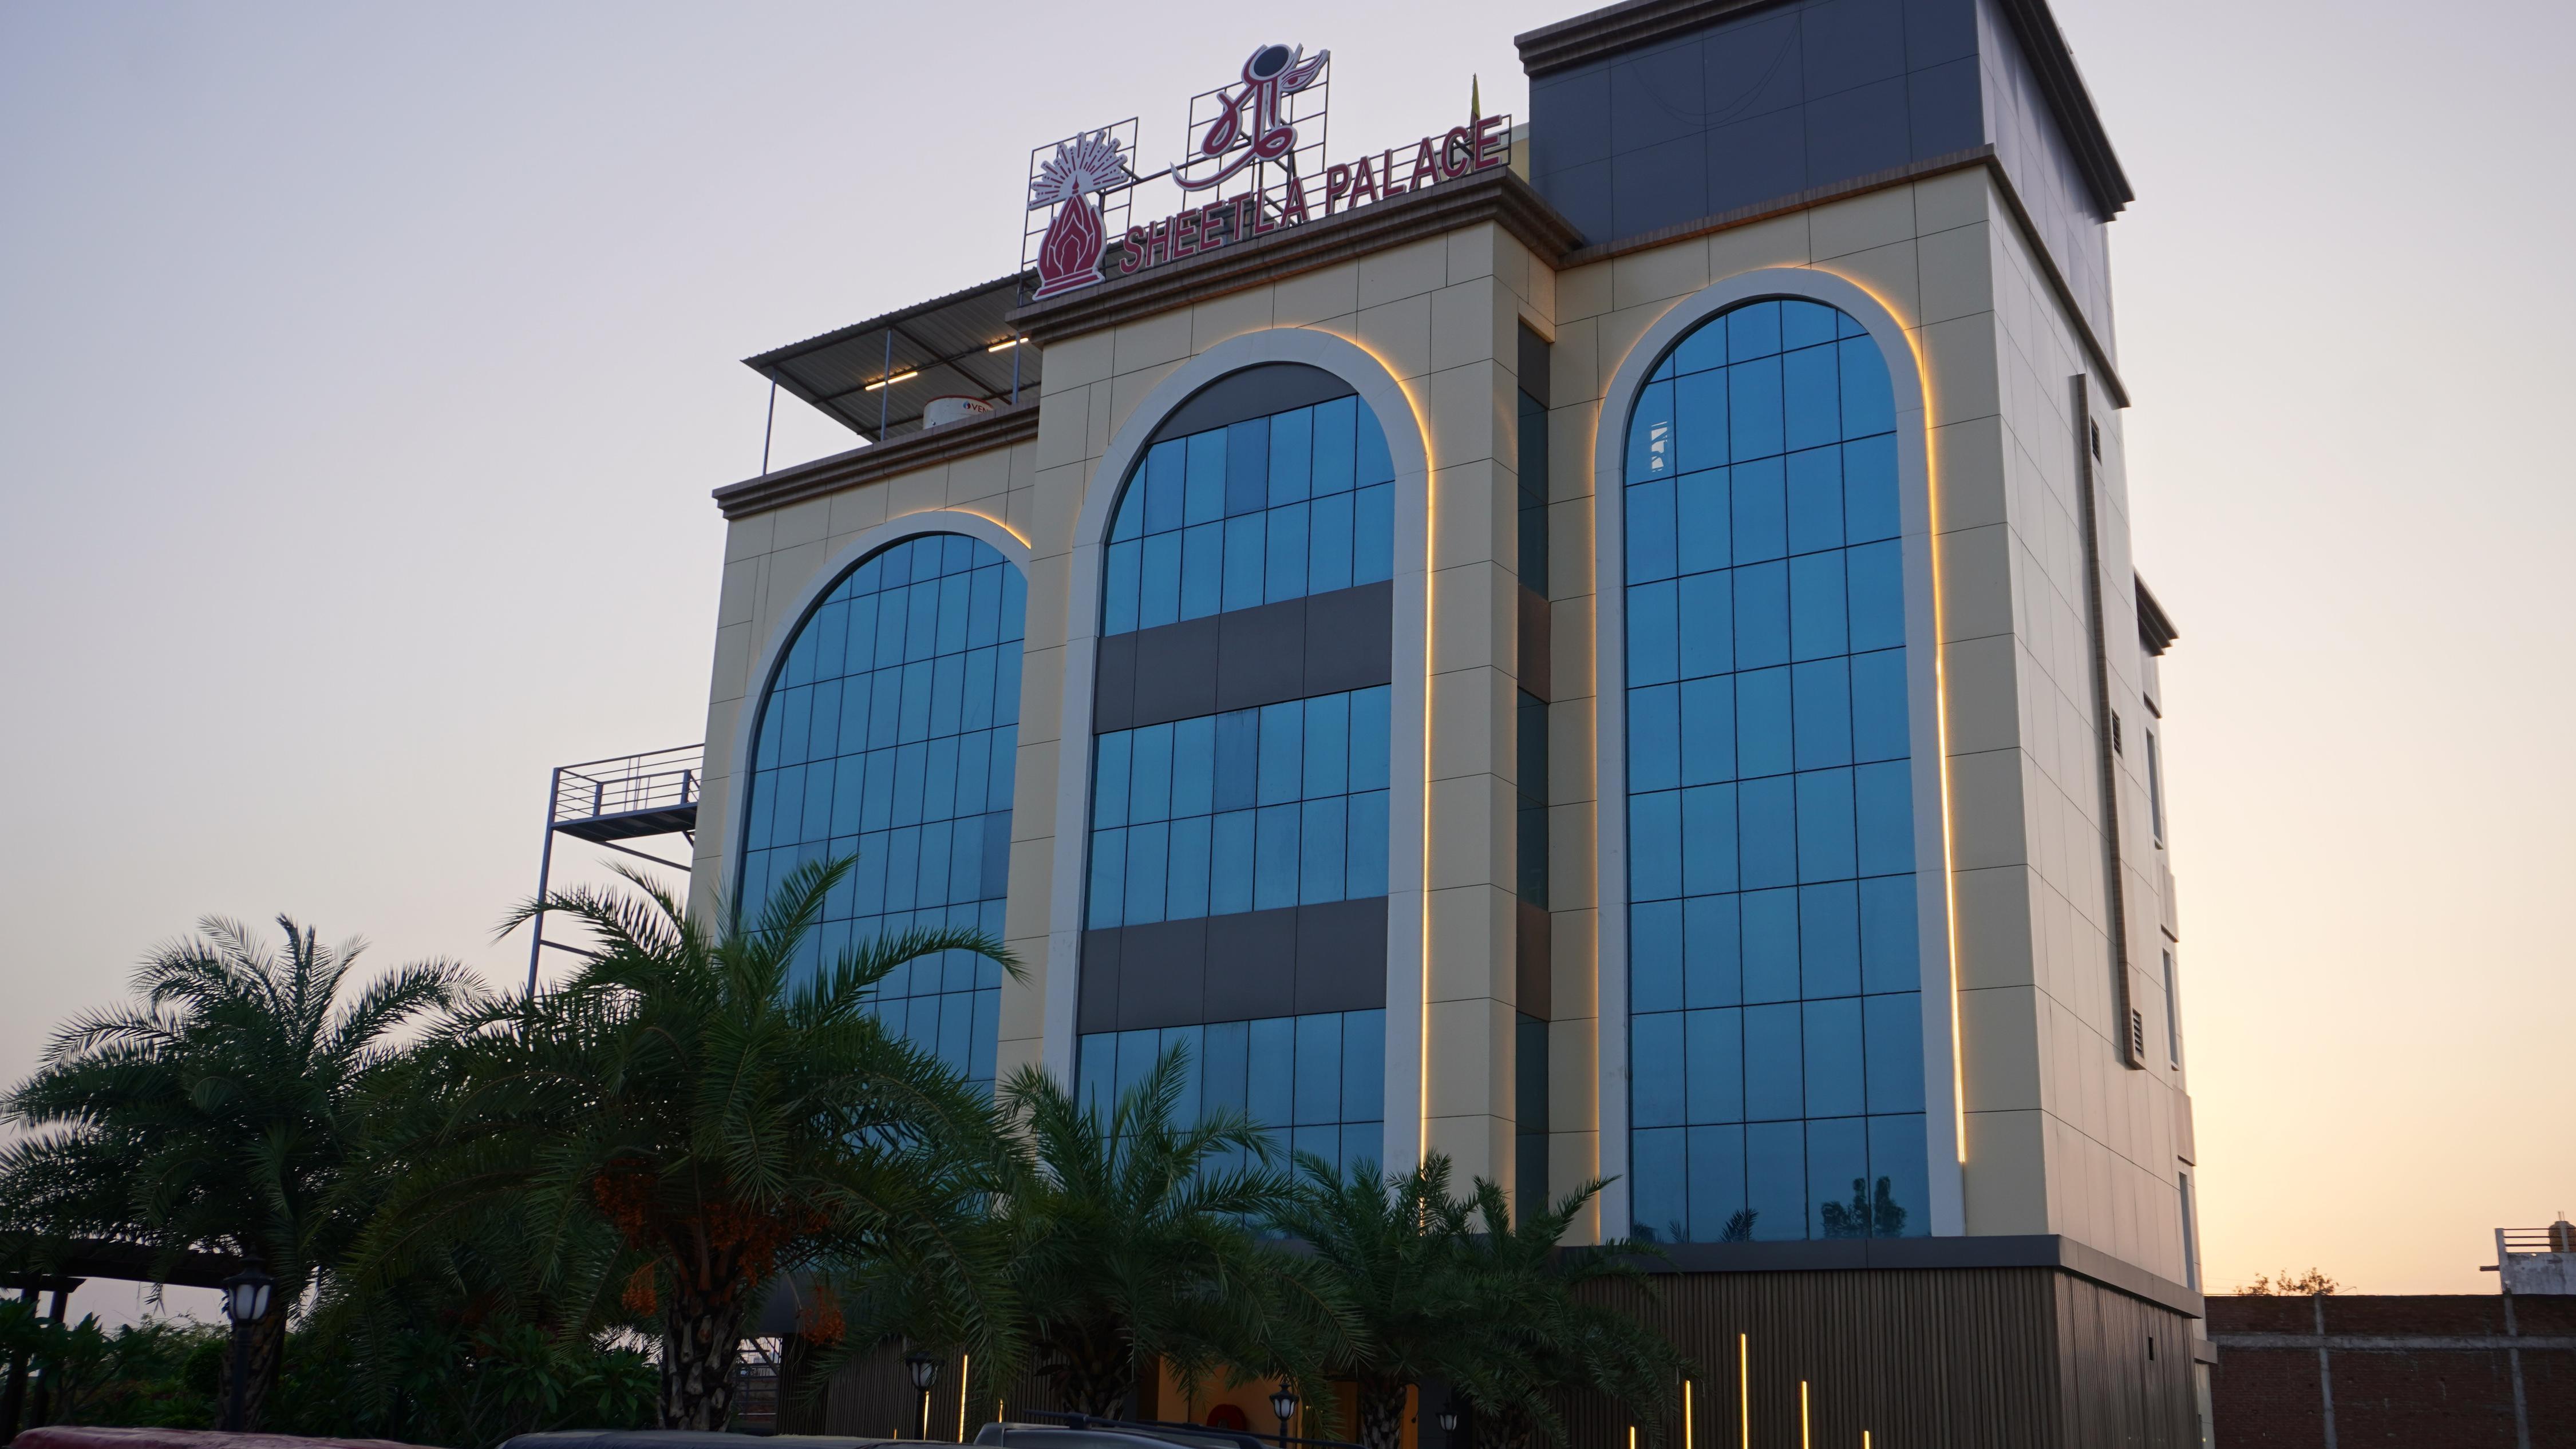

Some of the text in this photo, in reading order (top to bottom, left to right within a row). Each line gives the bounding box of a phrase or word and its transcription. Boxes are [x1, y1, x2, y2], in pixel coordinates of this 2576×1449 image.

[1120, 114, 1502, 274] SHEETLA PALACE
[971, 403, 990, 413] VEN
